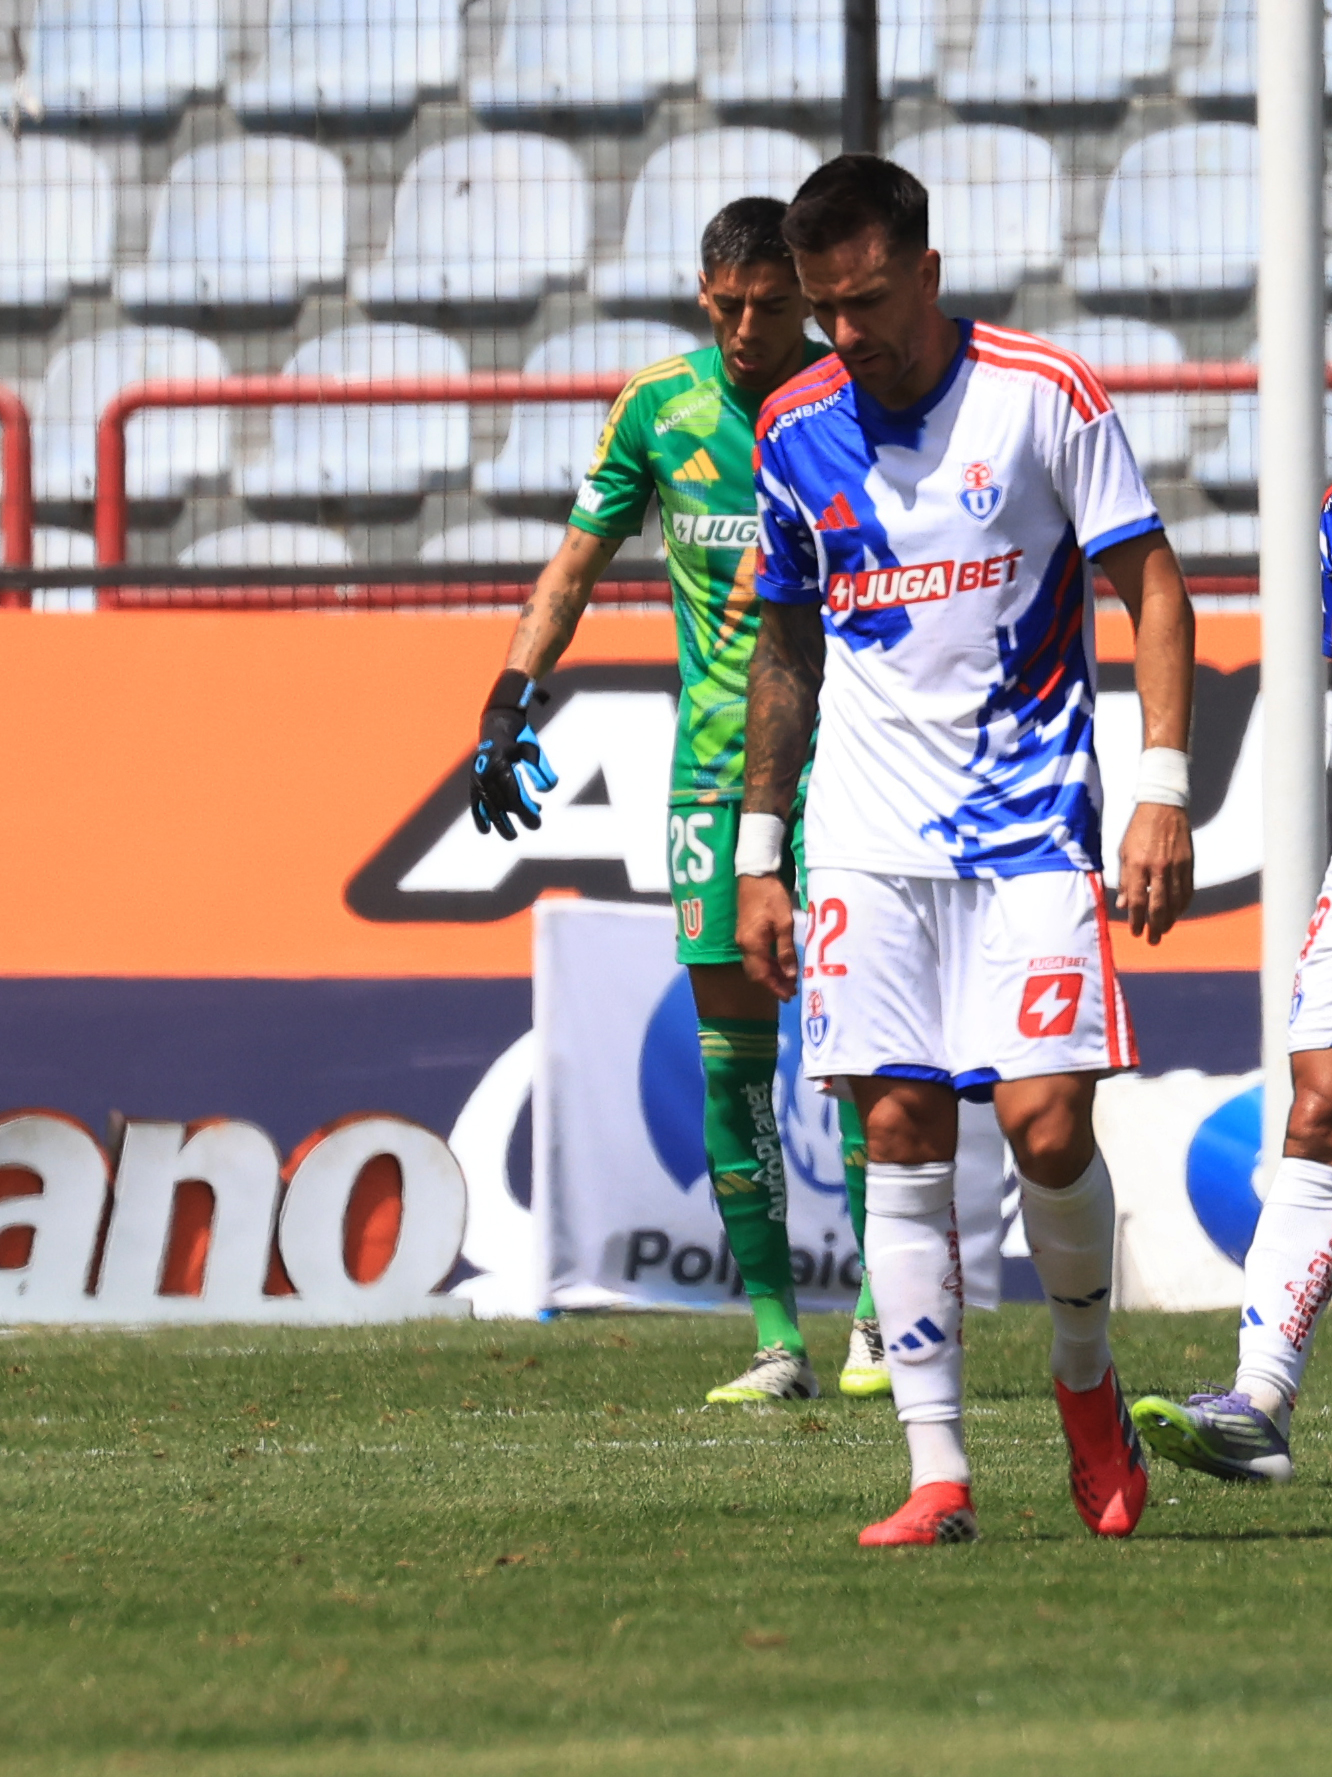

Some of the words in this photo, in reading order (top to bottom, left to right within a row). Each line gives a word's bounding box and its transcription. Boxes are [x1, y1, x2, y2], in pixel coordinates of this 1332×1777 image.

[697, 519, 758, 543] JUG
[856, 565, 947, 607] JUGA
[956, 549, 1023, 592] BET
[670, 812, 714, 884] 25
[681, 898, 703, 940] U
[803, 898, 848, 978] 22
